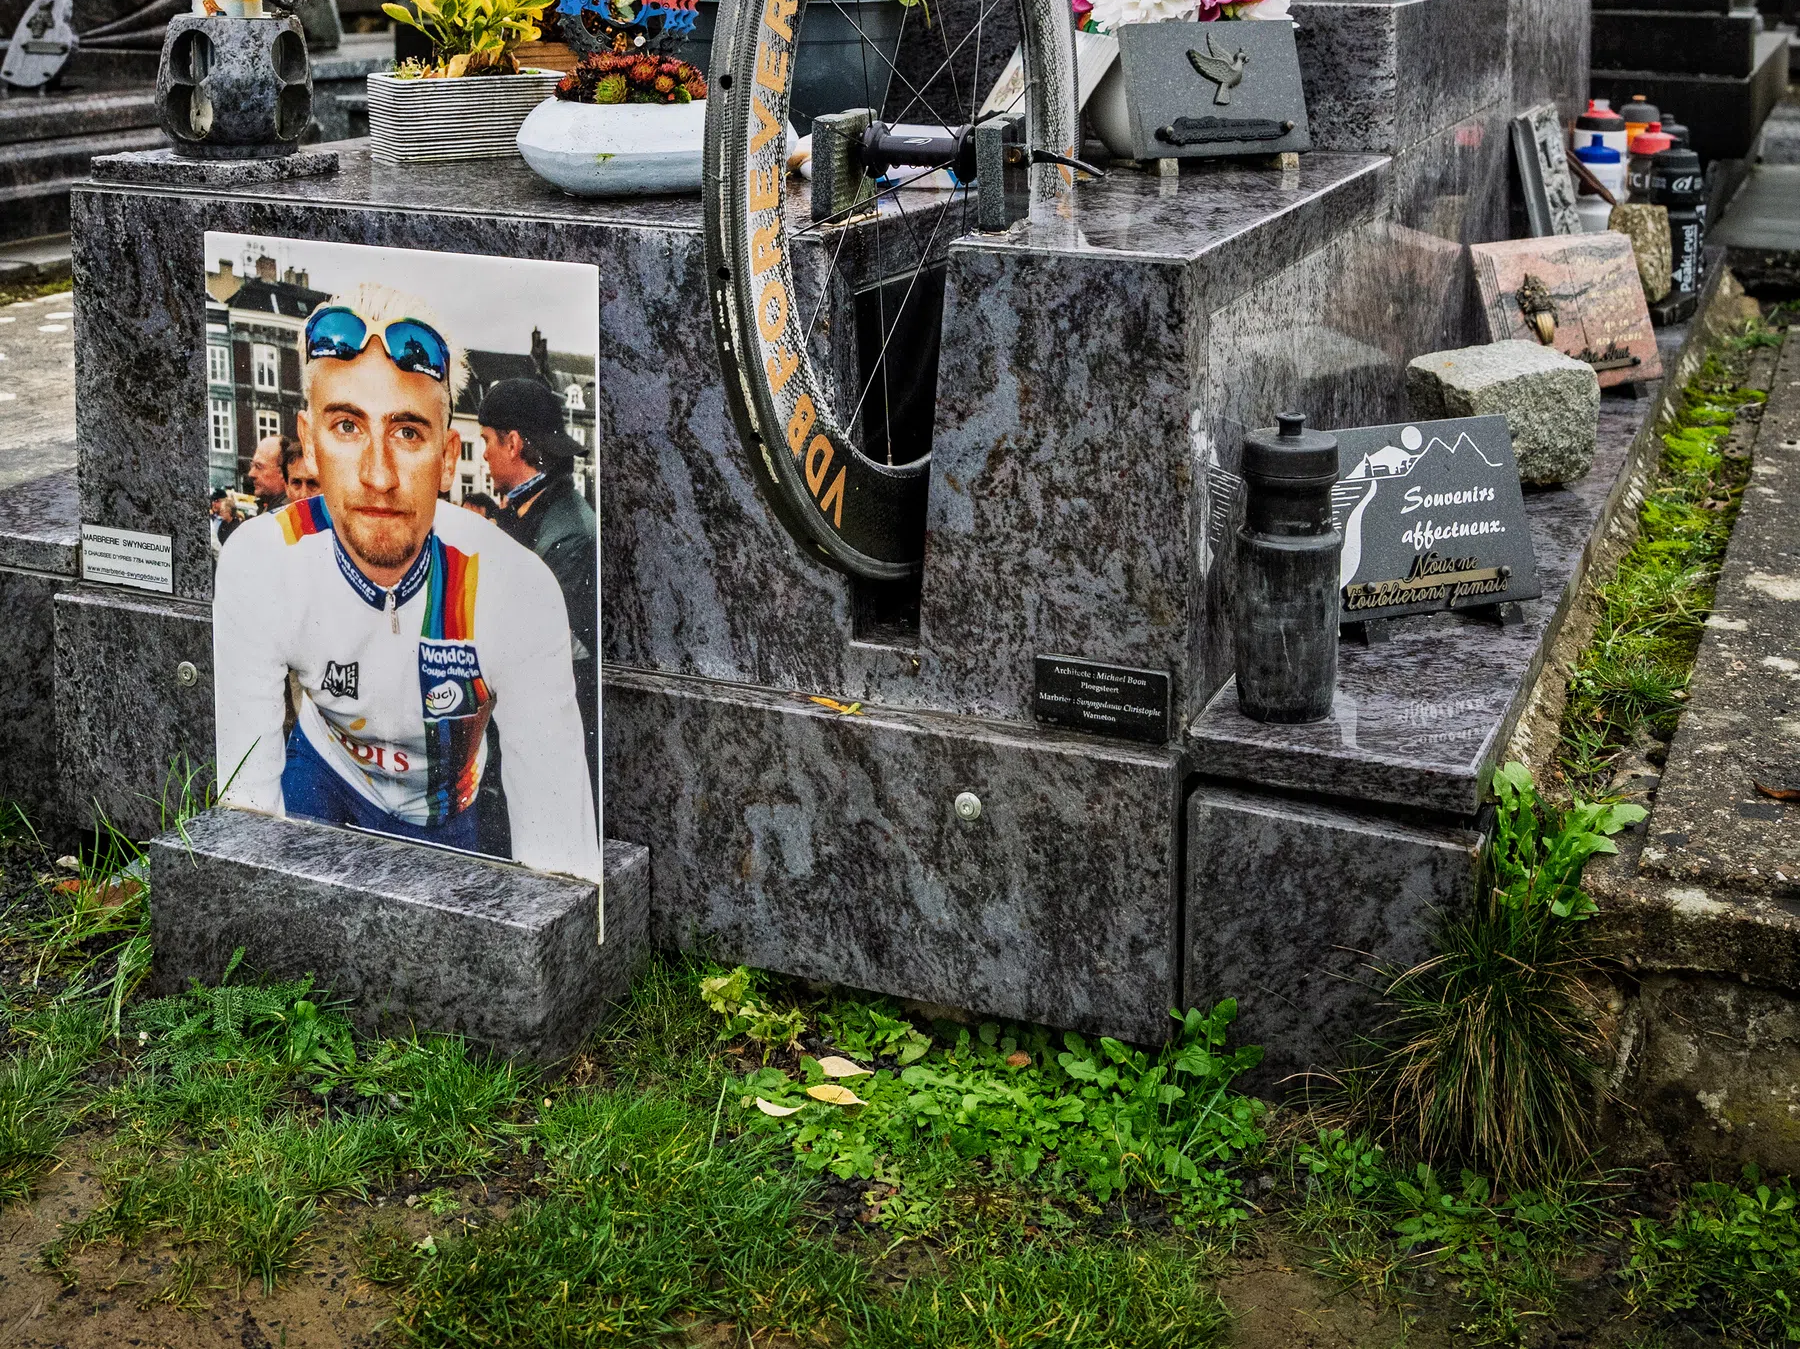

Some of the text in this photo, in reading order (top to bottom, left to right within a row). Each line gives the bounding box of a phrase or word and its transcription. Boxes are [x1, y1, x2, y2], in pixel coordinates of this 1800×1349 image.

[787, 393, 849, 529] VDB
[1400, 484, 1495, 515] Souvenirs
[83, 533, 171, 554] MARBRERIE SWYNGEDAUW
[1401, 519, 1506, 551] affectueux.
[1403, 551, 1479, 584] Nous ne
[1450, 576, 1508, 608] jamais
[1054, 666, 1092, 679] Architecte
[1127, 677, 1147, 686] Boon
[1081, 682, 1120, 694] Ploegsteert
[1039, 692, 1072, 703] Marbrier
[1123, 704, 1162, 717] Christophe
[1082, 711, 1116, 722] Warneton
